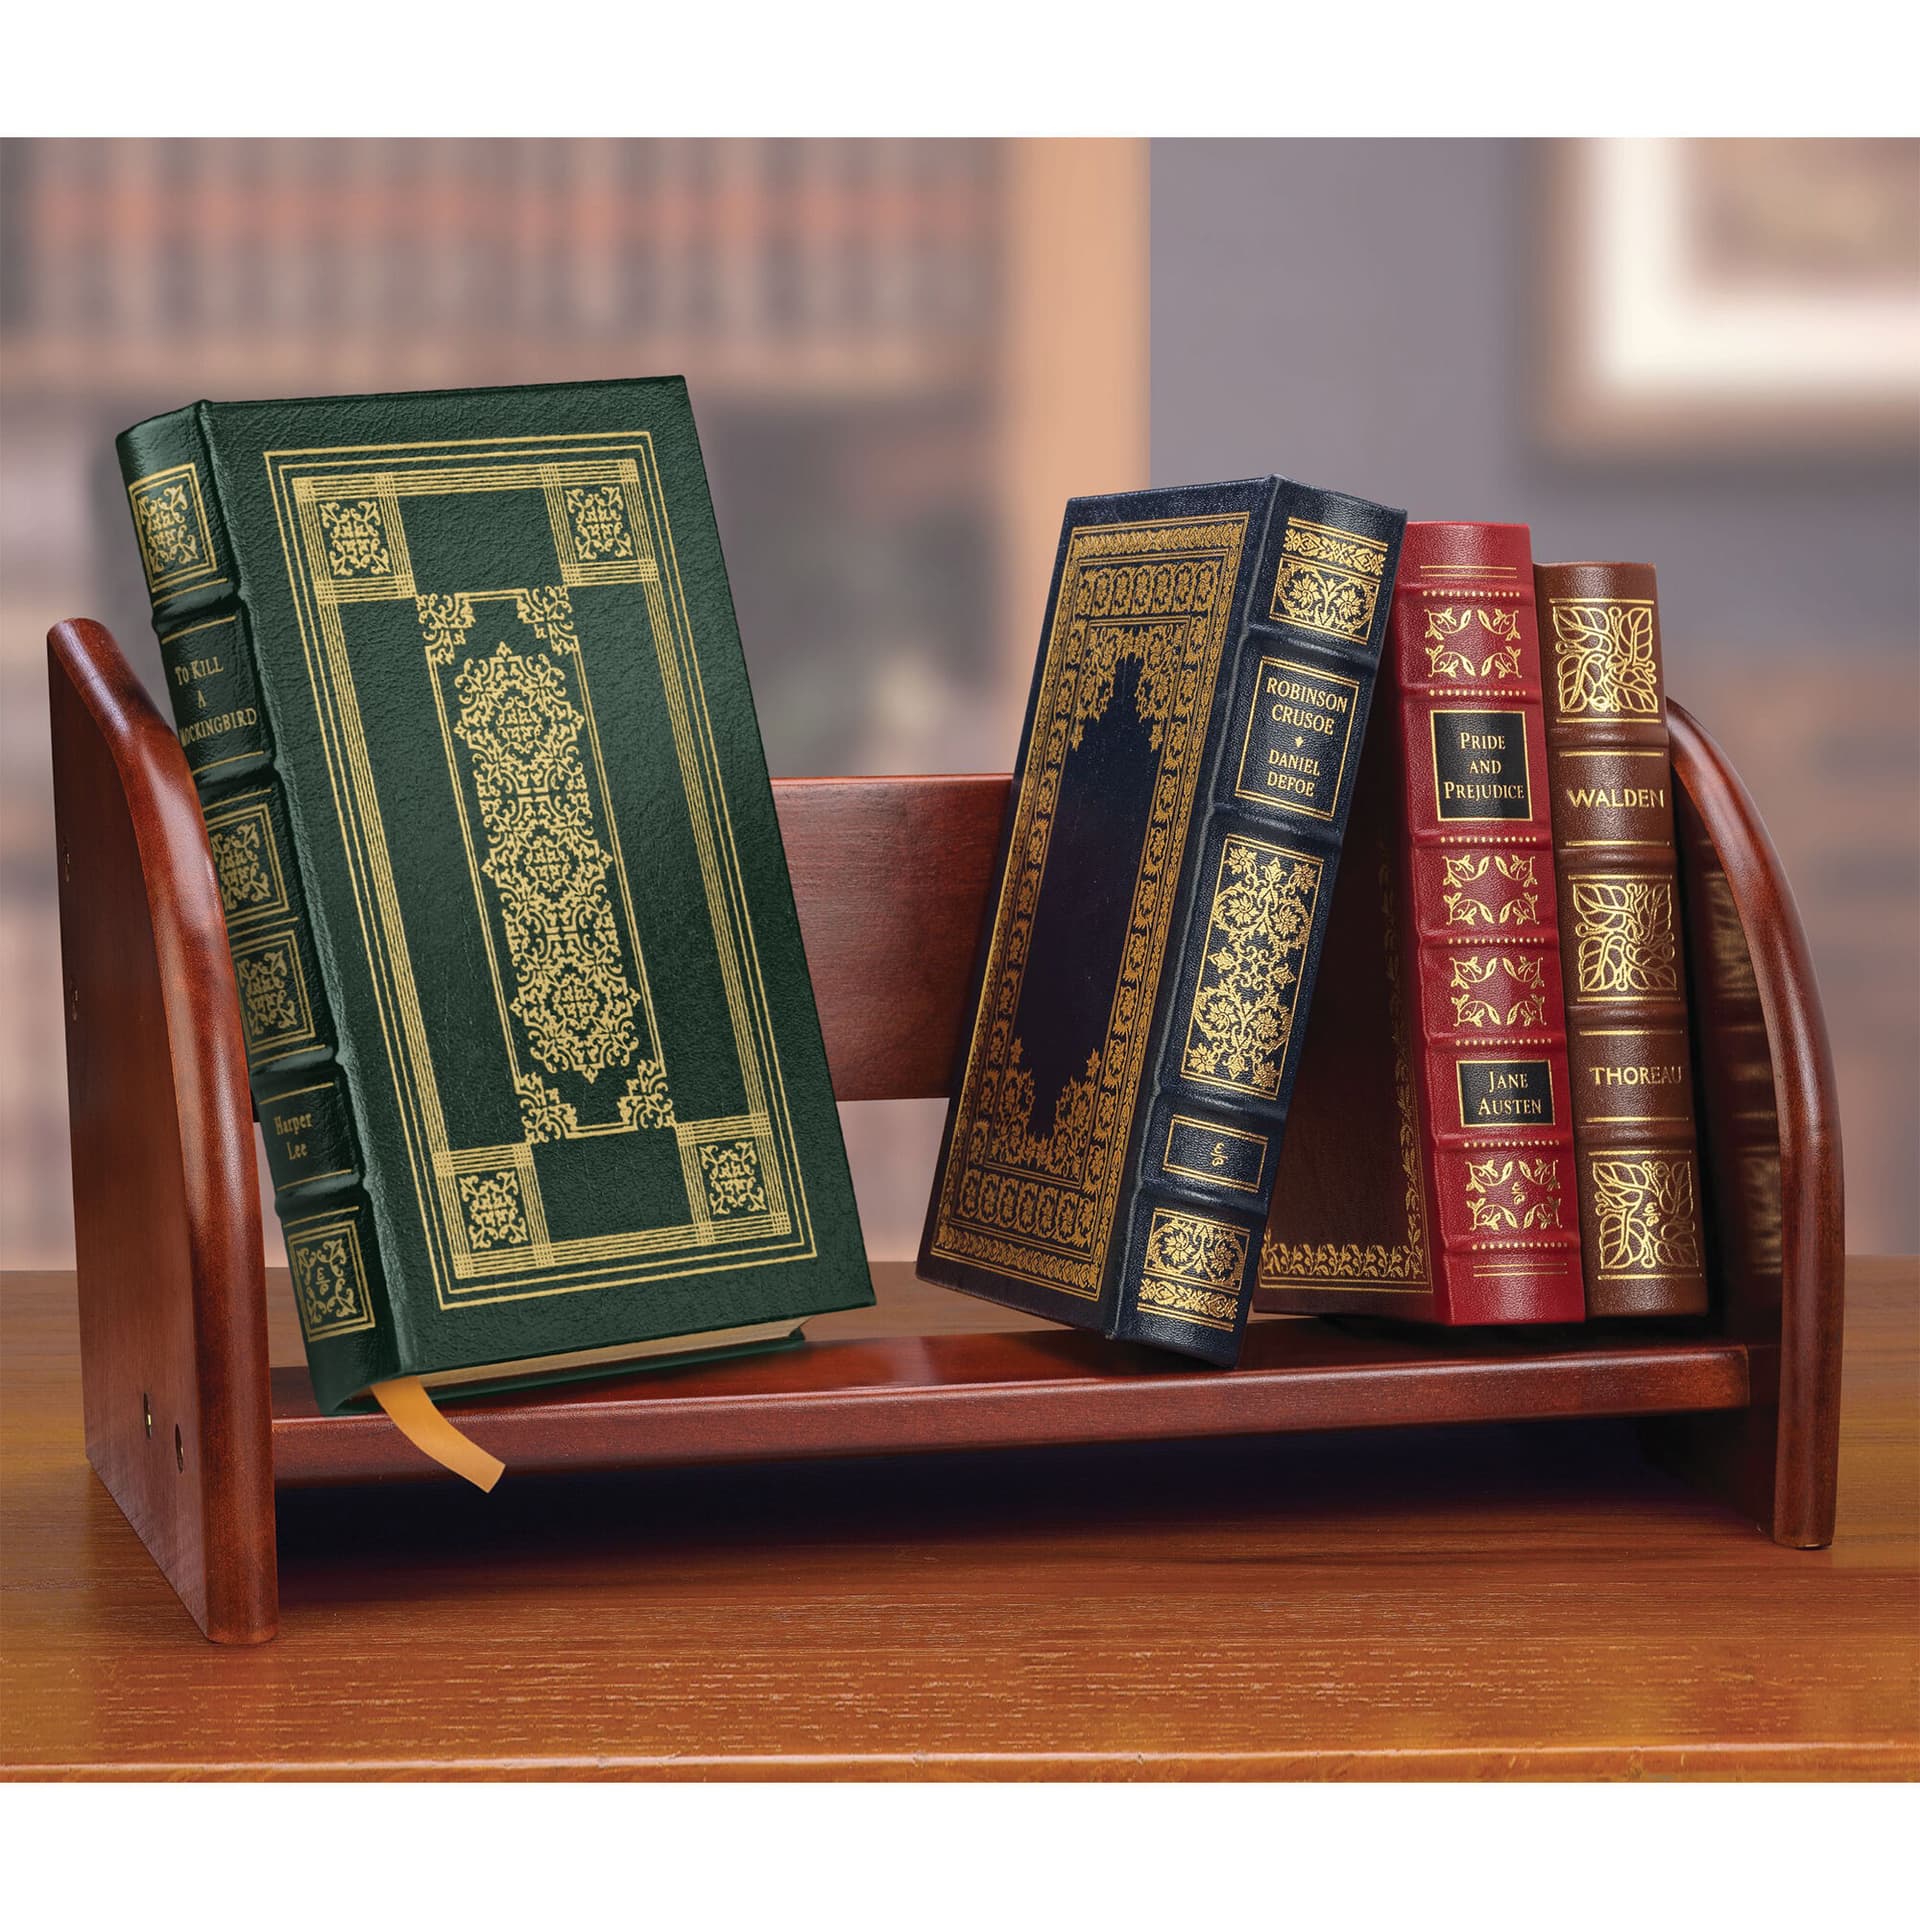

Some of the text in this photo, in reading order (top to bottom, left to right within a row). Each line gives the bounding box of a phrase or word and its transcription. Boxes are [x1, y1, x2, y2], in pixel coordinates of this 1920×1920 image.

[175, 656, 224, 686] TO KILL
[197, 689, 206, 709] A
[1266, 677, 1348, 713] ROBINSON
[1271, 704, 1335, 735] CRUSOE
[1268, 749, 1320, 776] DANIEL
[1266, 771, 1315, 797] DEFOE
[1566, 789, 1664, 808] WALDEN
[1589, 1066, 1682, 1086] THOREAU
[273, 1113, 313, 1135] Harper
[286, 1142, 308, 1160] Lee
